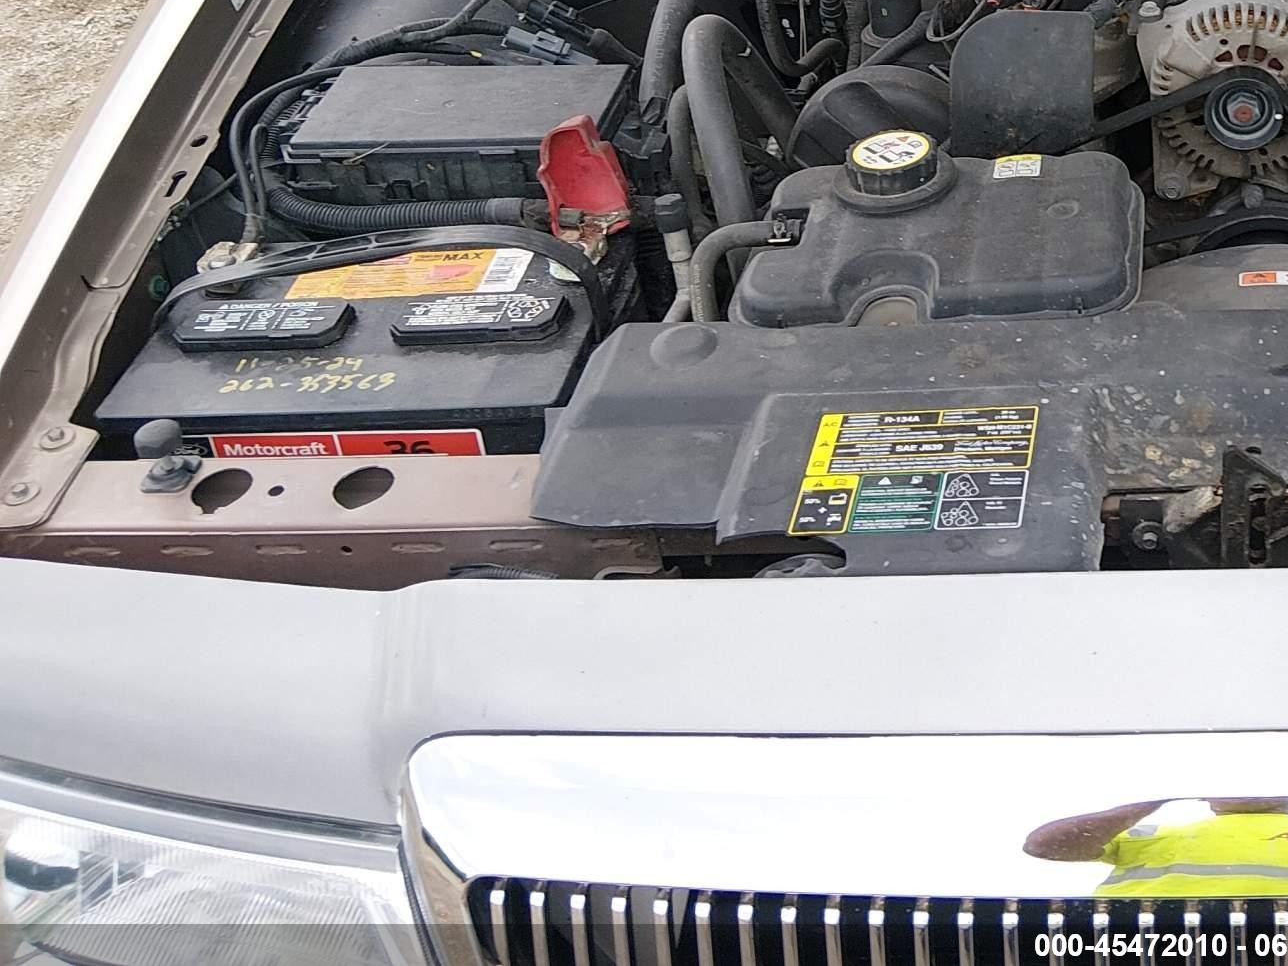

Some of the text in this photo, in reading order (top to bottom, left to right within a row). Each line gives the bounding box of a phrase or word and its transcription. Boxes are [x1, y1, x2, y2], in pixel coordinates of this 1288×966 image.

[443, 251, 484, 263] MAX
[223, 441, 329, 457] Motorcraft
[895, 444, 917, 452] SAE
